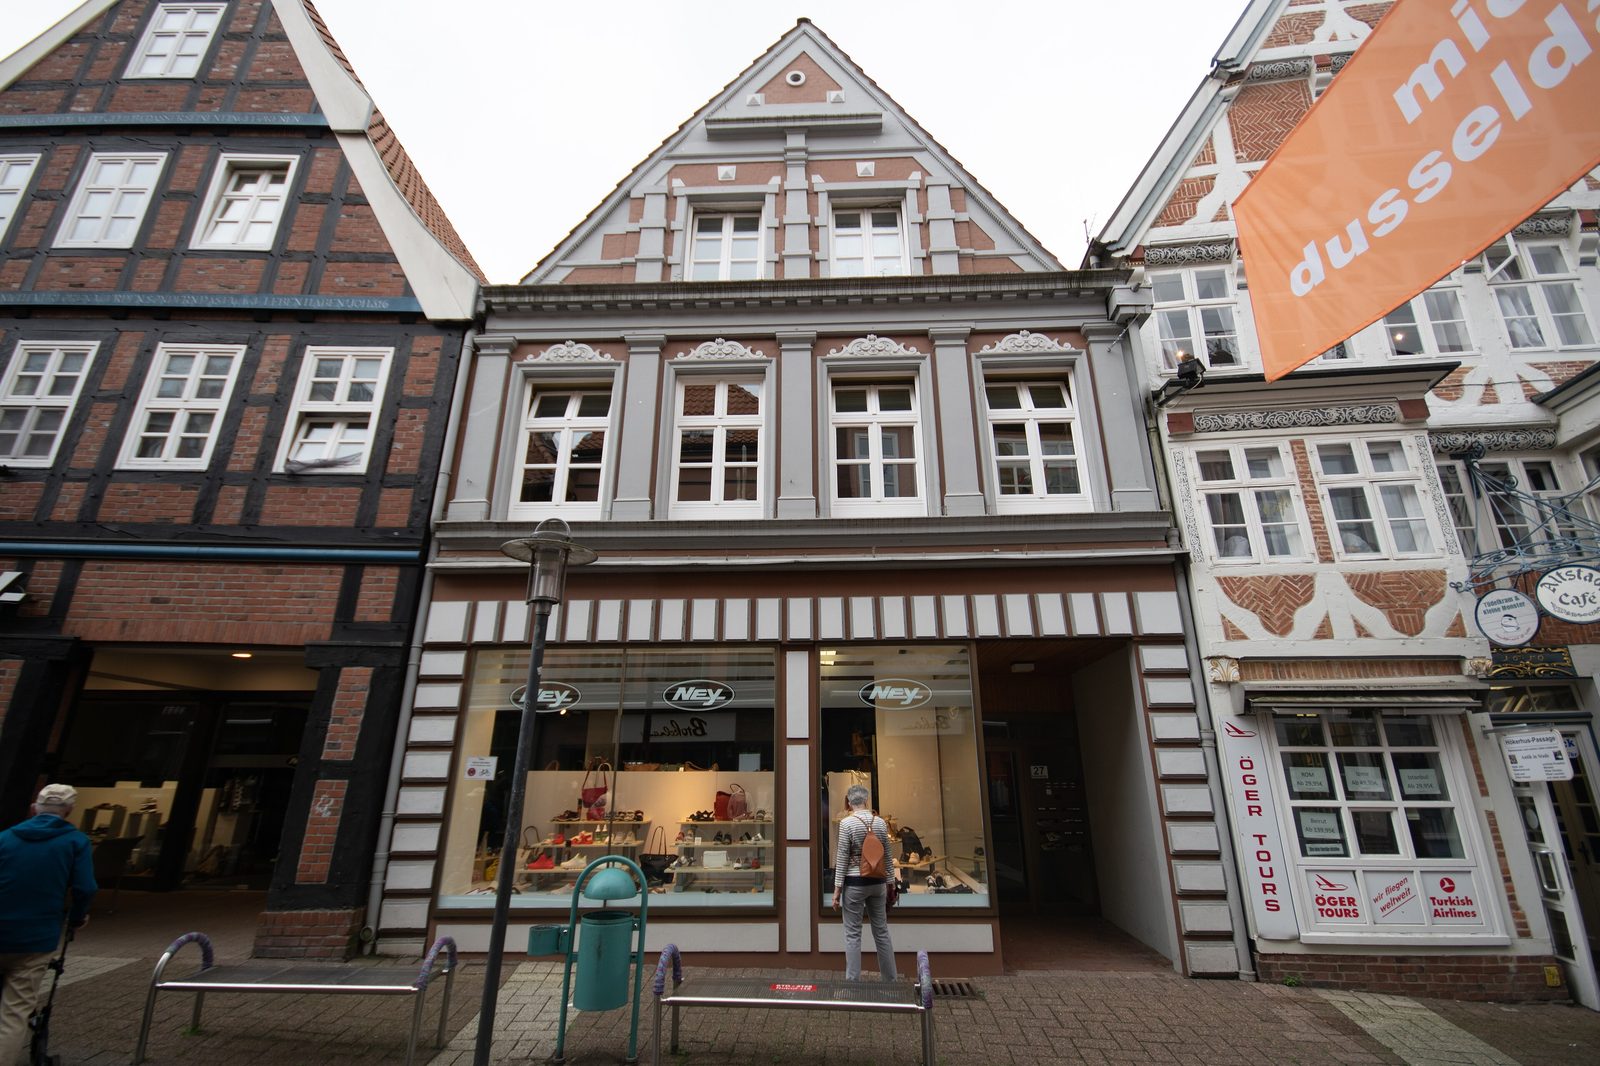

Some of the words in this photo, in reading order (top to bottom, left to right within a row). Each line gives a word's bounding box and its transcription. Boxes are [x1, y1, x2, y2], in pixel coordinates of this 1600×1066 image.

[1290, 3, 1600, 297] dusseld
[1559, 592, 1598, 608] Café
[1033, 766, 1045, 775] 27
[1239, 756, 1263, 817] ÖGER
[1252, 834, 1281, 912] TOURS
[1372, 891, 1384, 904] wir
[1384, 876, 1409, 896] fliegen
[1315, 894, 1357, 906] ÖGER
[1379, 887, 1412, 913] weltweit
[1429, 896, 1473, 906] Turkish
[1318, 908, 1360, 918] TOURS
[1433, 908, 1477, 918] Airlines
